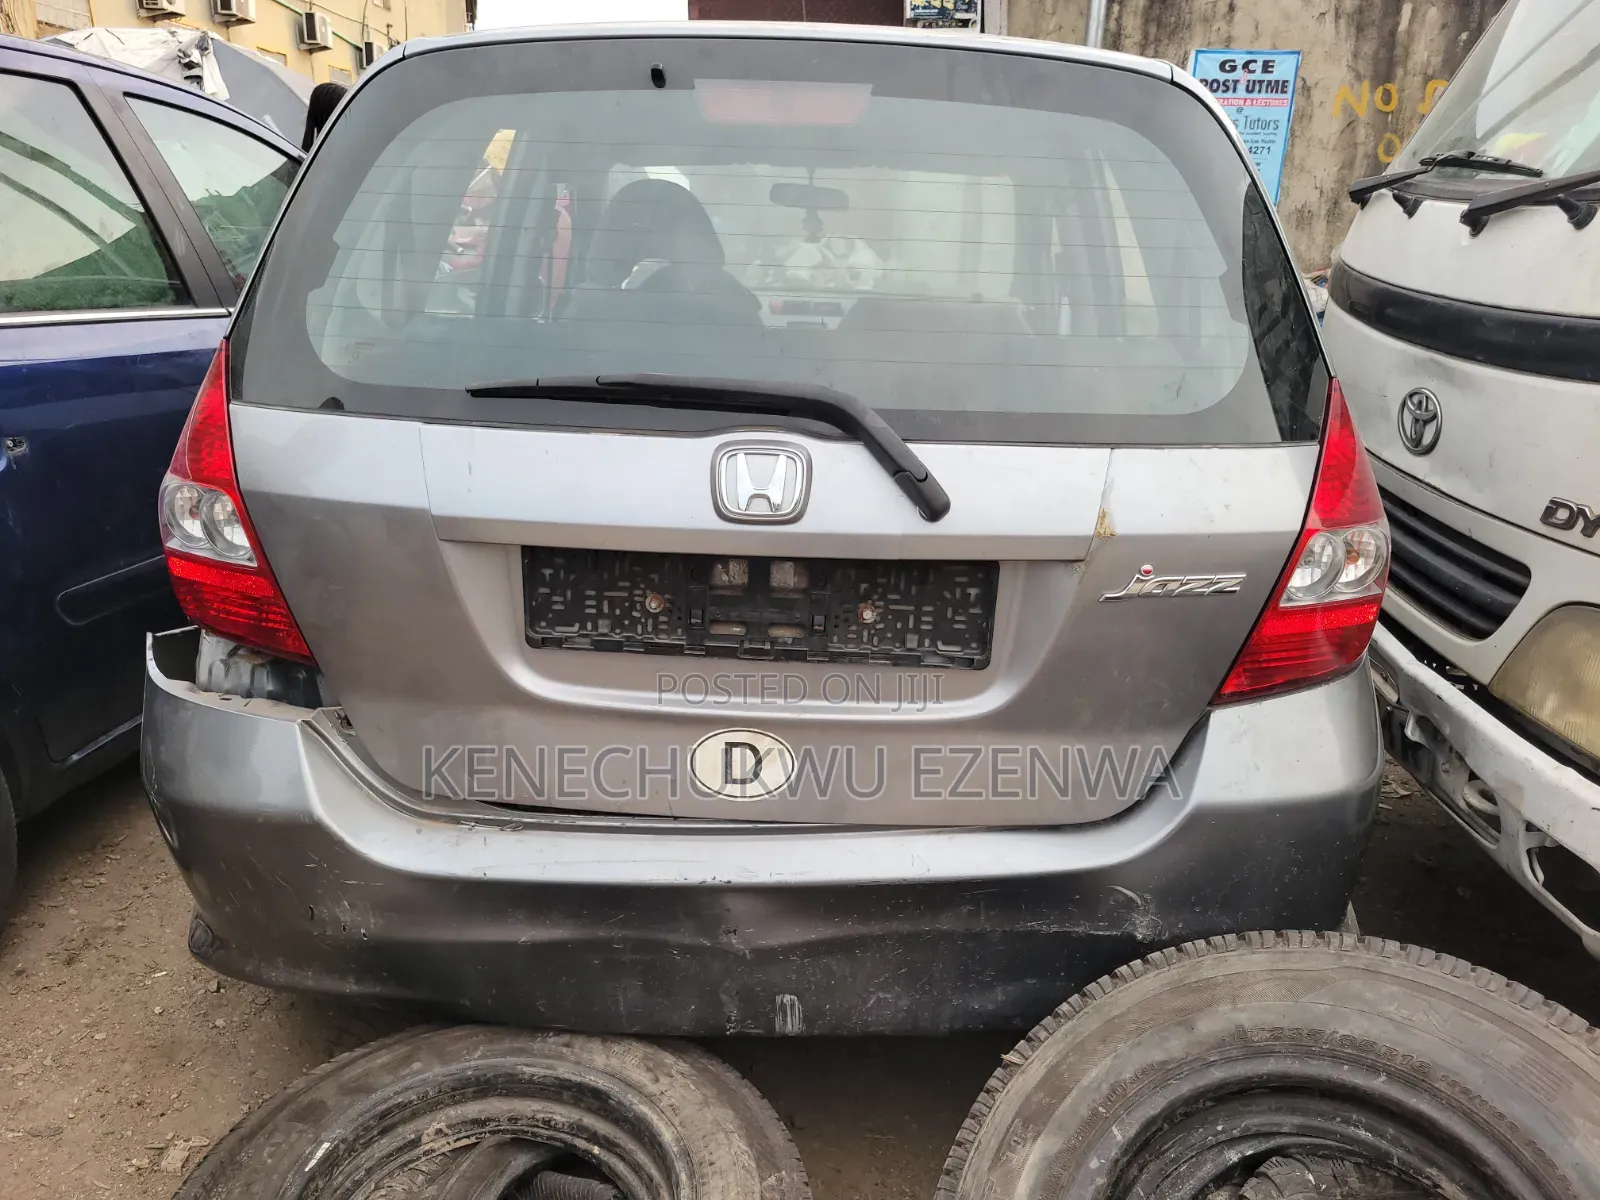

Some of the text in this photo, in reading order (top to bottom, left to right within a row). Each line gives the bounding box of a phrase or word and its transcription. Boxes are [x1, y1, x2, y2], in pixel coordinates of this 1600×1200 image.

[1219, 59, 1275, 74] GCE
[1246, 80, 1289, 94] UTME
[1254, 99, 1288, 107] LECTURES
[1243, 115, 1280, 131] Tutors
[724, 741, 763, 785] D
